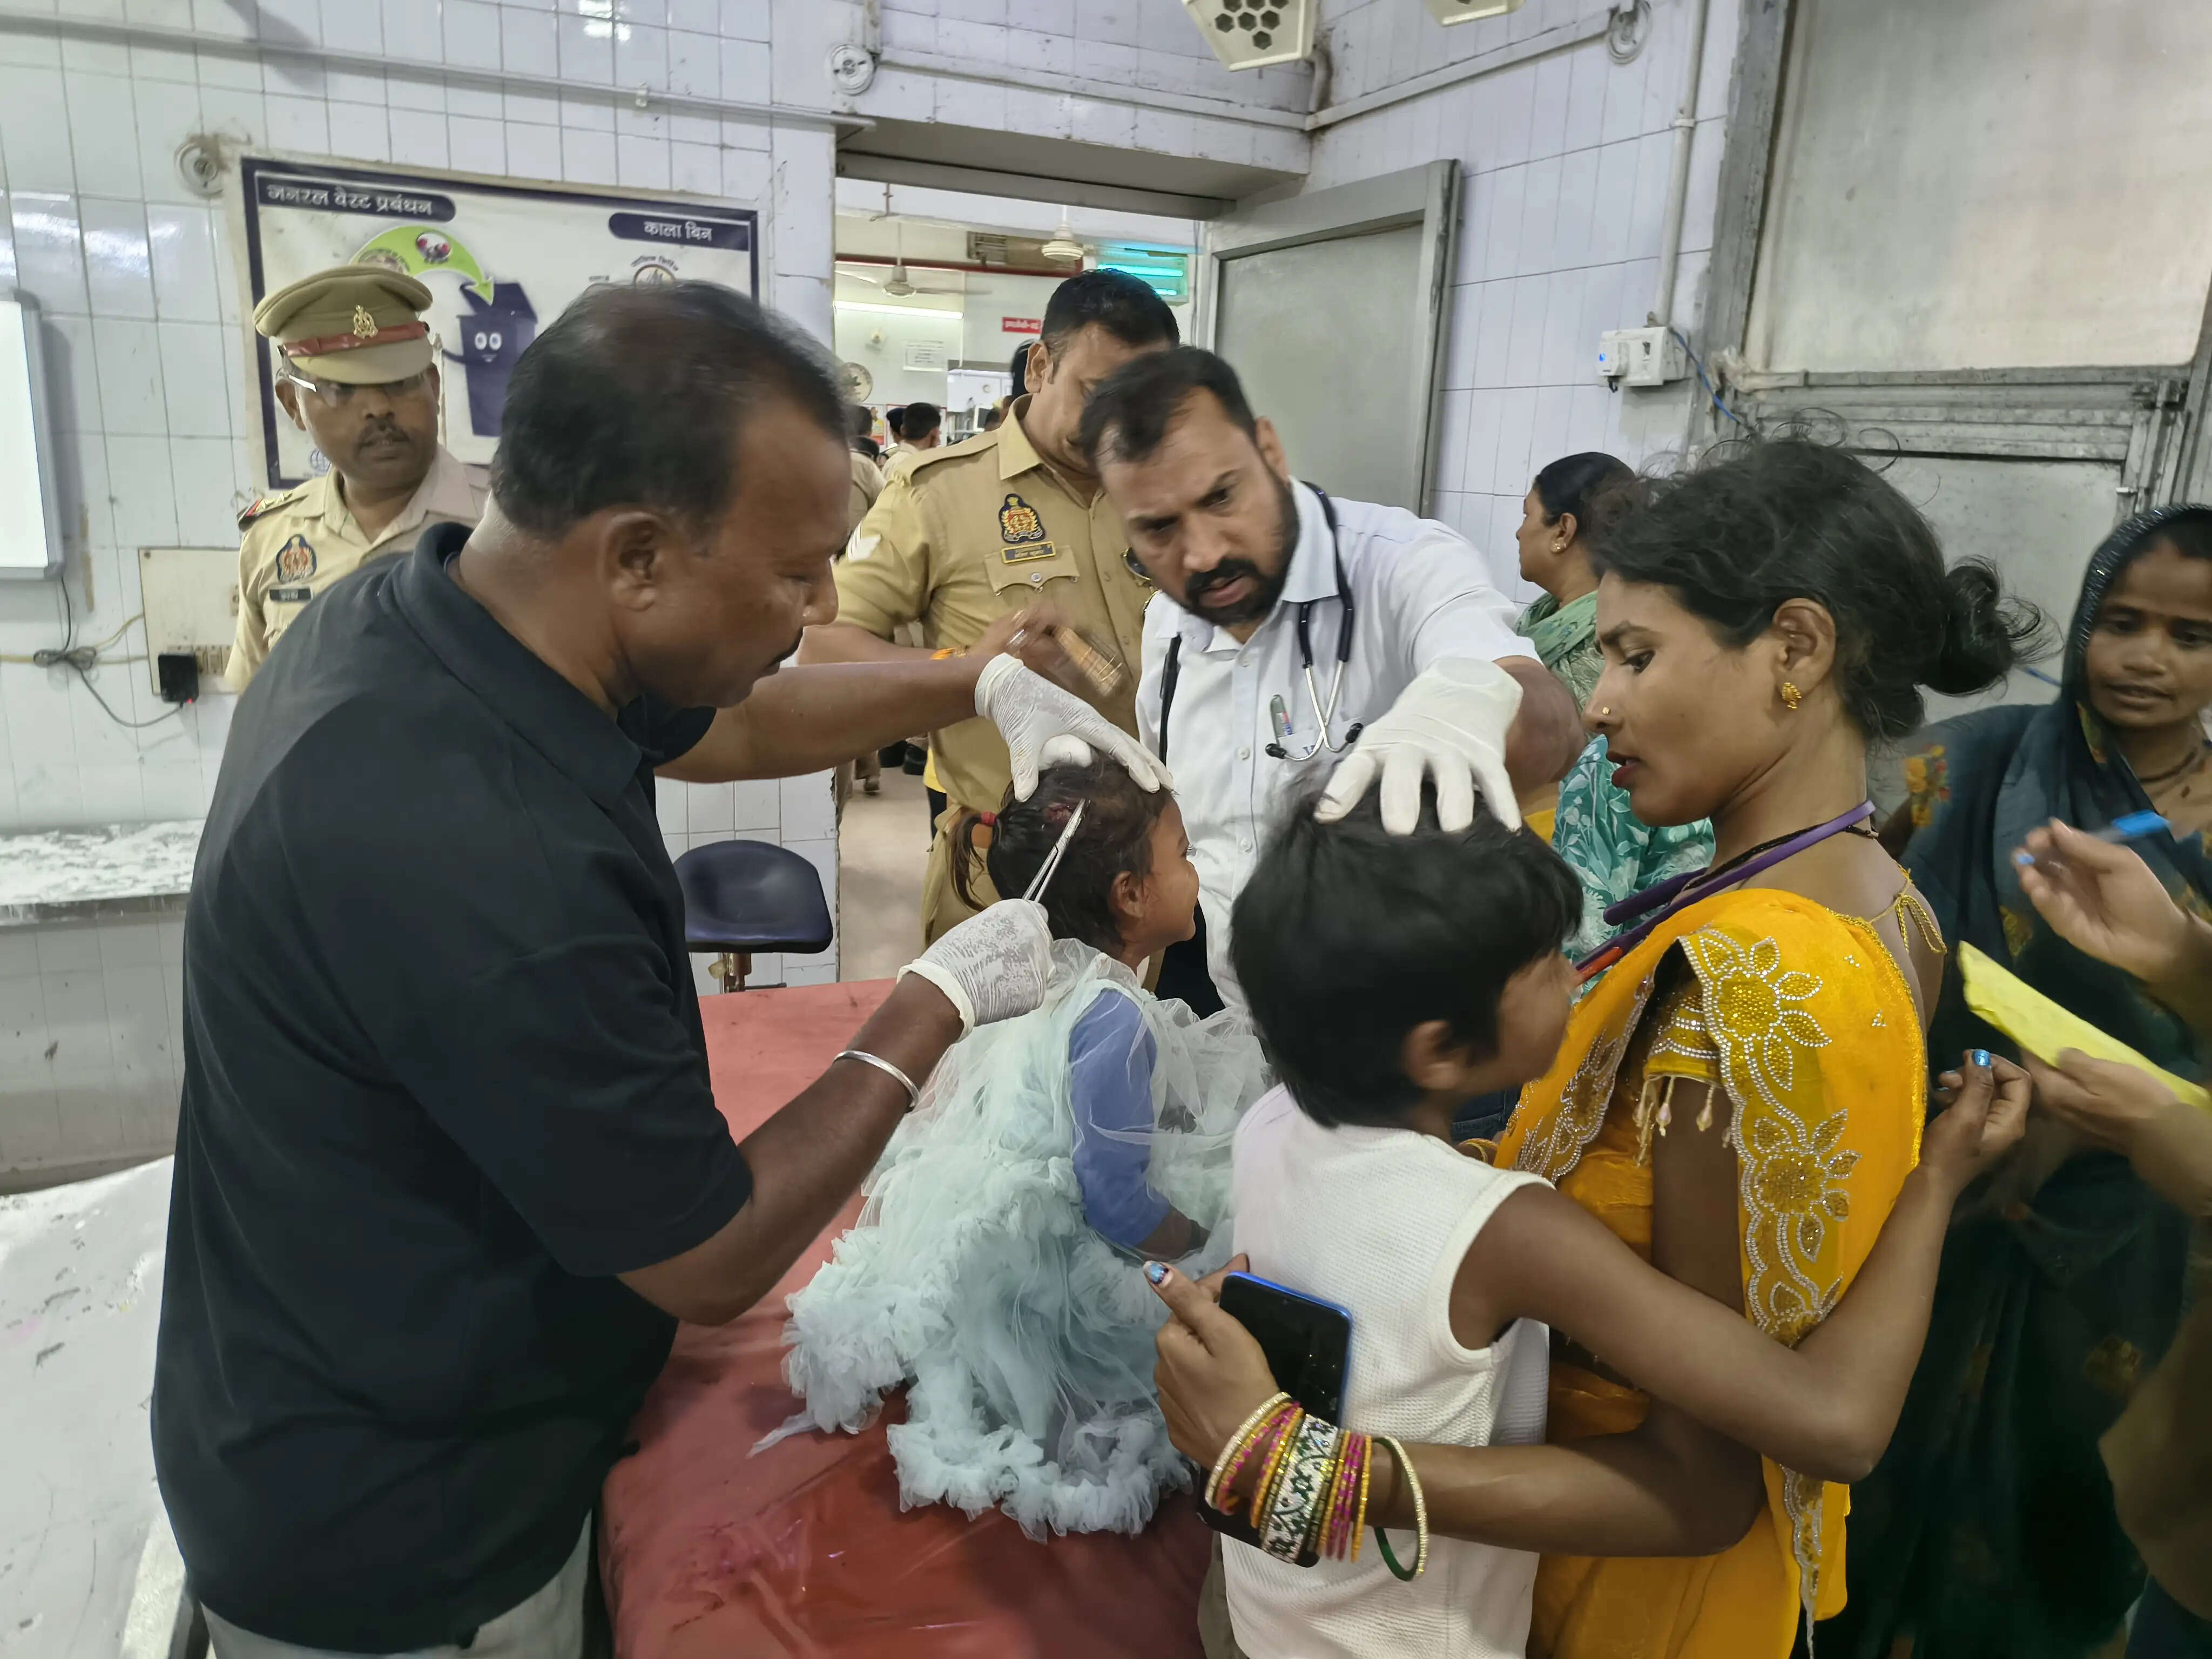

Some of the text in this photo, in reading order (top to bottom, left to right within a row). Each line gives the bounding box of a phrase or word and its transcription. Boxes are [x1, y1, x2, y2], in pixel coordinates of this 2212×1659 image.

[267, 184, 329, 206] जनरल
[375, 193, 433, 215] प्रबंधन
[644, 220, 713, 241] काला बिन
